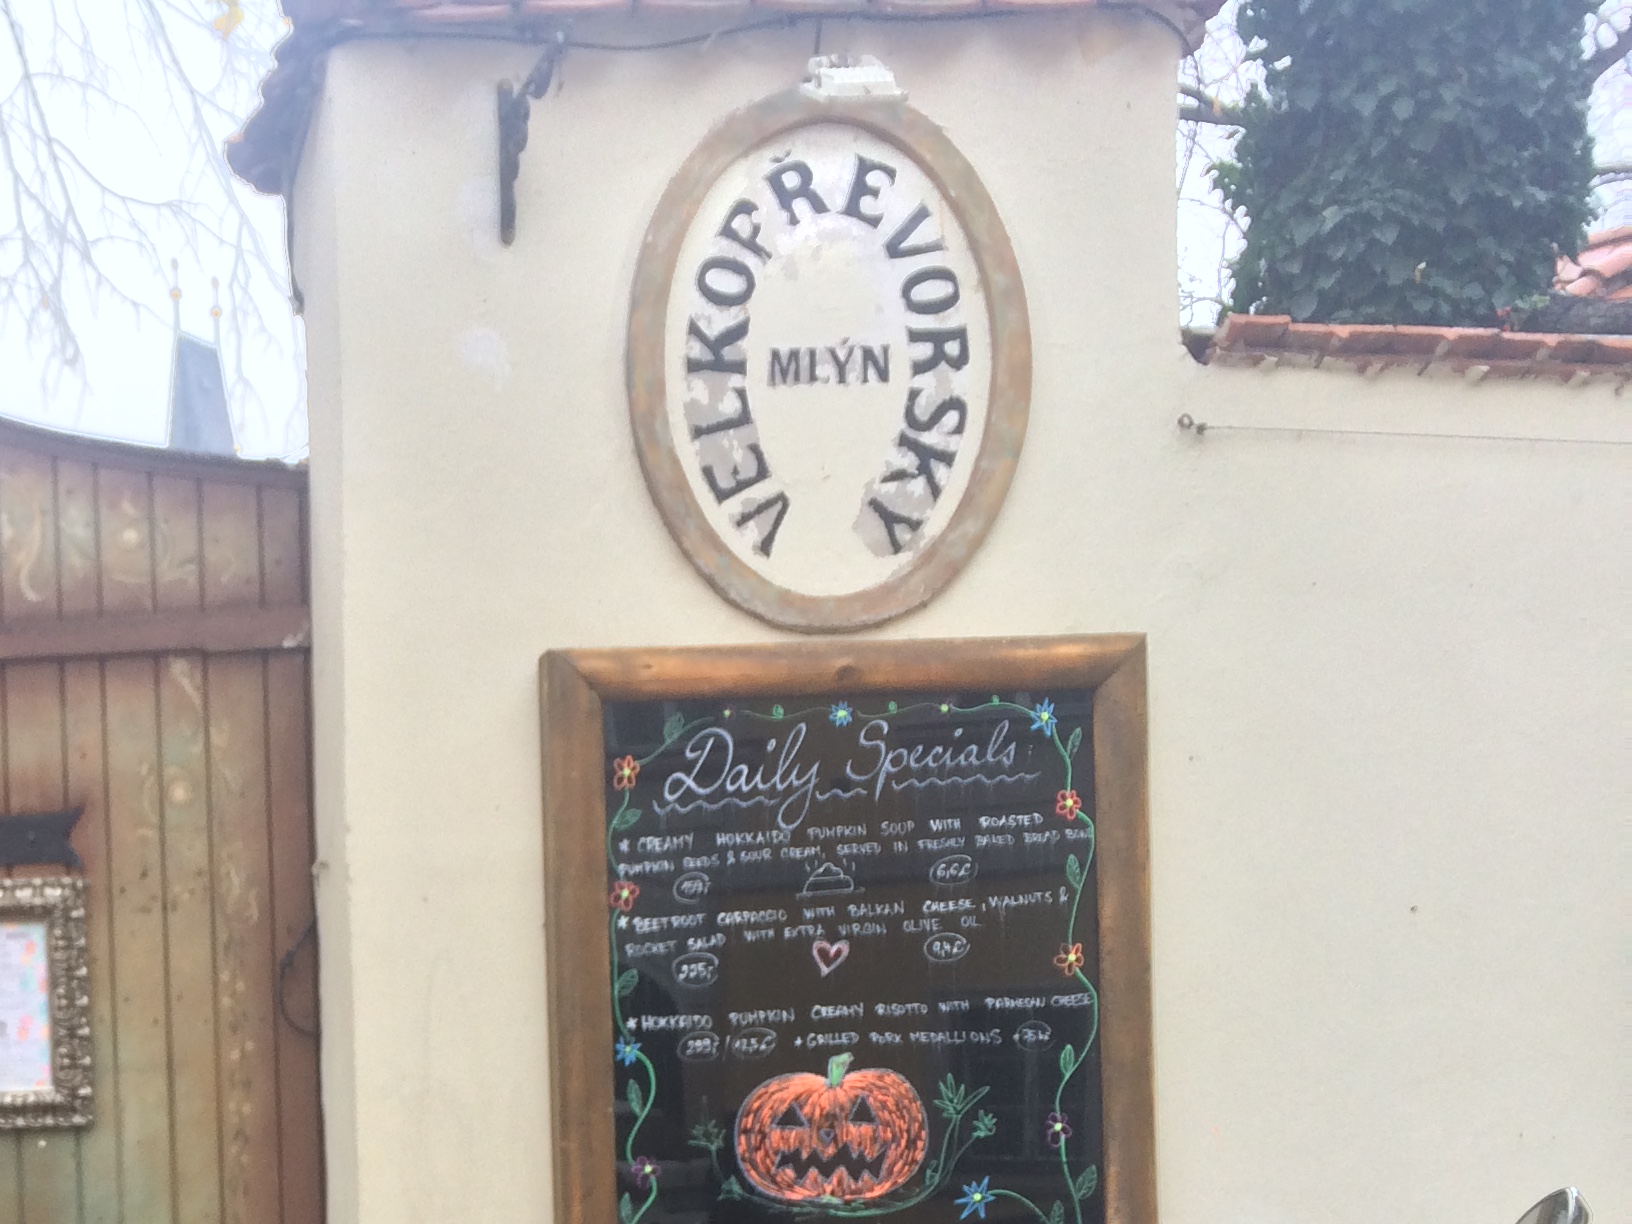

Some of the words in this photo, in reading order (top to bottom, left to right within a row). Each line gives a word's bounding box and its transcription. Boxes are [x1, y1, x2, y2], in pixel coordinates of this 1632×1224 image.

[663, 722, 820, 831] Daily
[807, 824, 867, 842] PUMPKIN
[881, 820, 915, 836] SOUP
[929, 817, 961, 833] WITH
[979, 812, 1044, 828] ROASTED
[893, 840, 908, 853] IN
[632, 913, 706, 934] BEETROOT
[803, 905, 835, 921] WITH
[848, 900, 904, 919] BALKAN
[988, 890, 1053, 909] WALNUTS
[743, 928, 775, 943] WITH
[784, 924, 825, 940] EXTRA
[838, 920, 887, 937] VIRGIN
[903, 917, 943, 932] OLIVE
[961, 914, 982, 929] OIL
[874, 1002, 929, 1017] RISOTTO
[938, 998, 970, 1014] WITH
